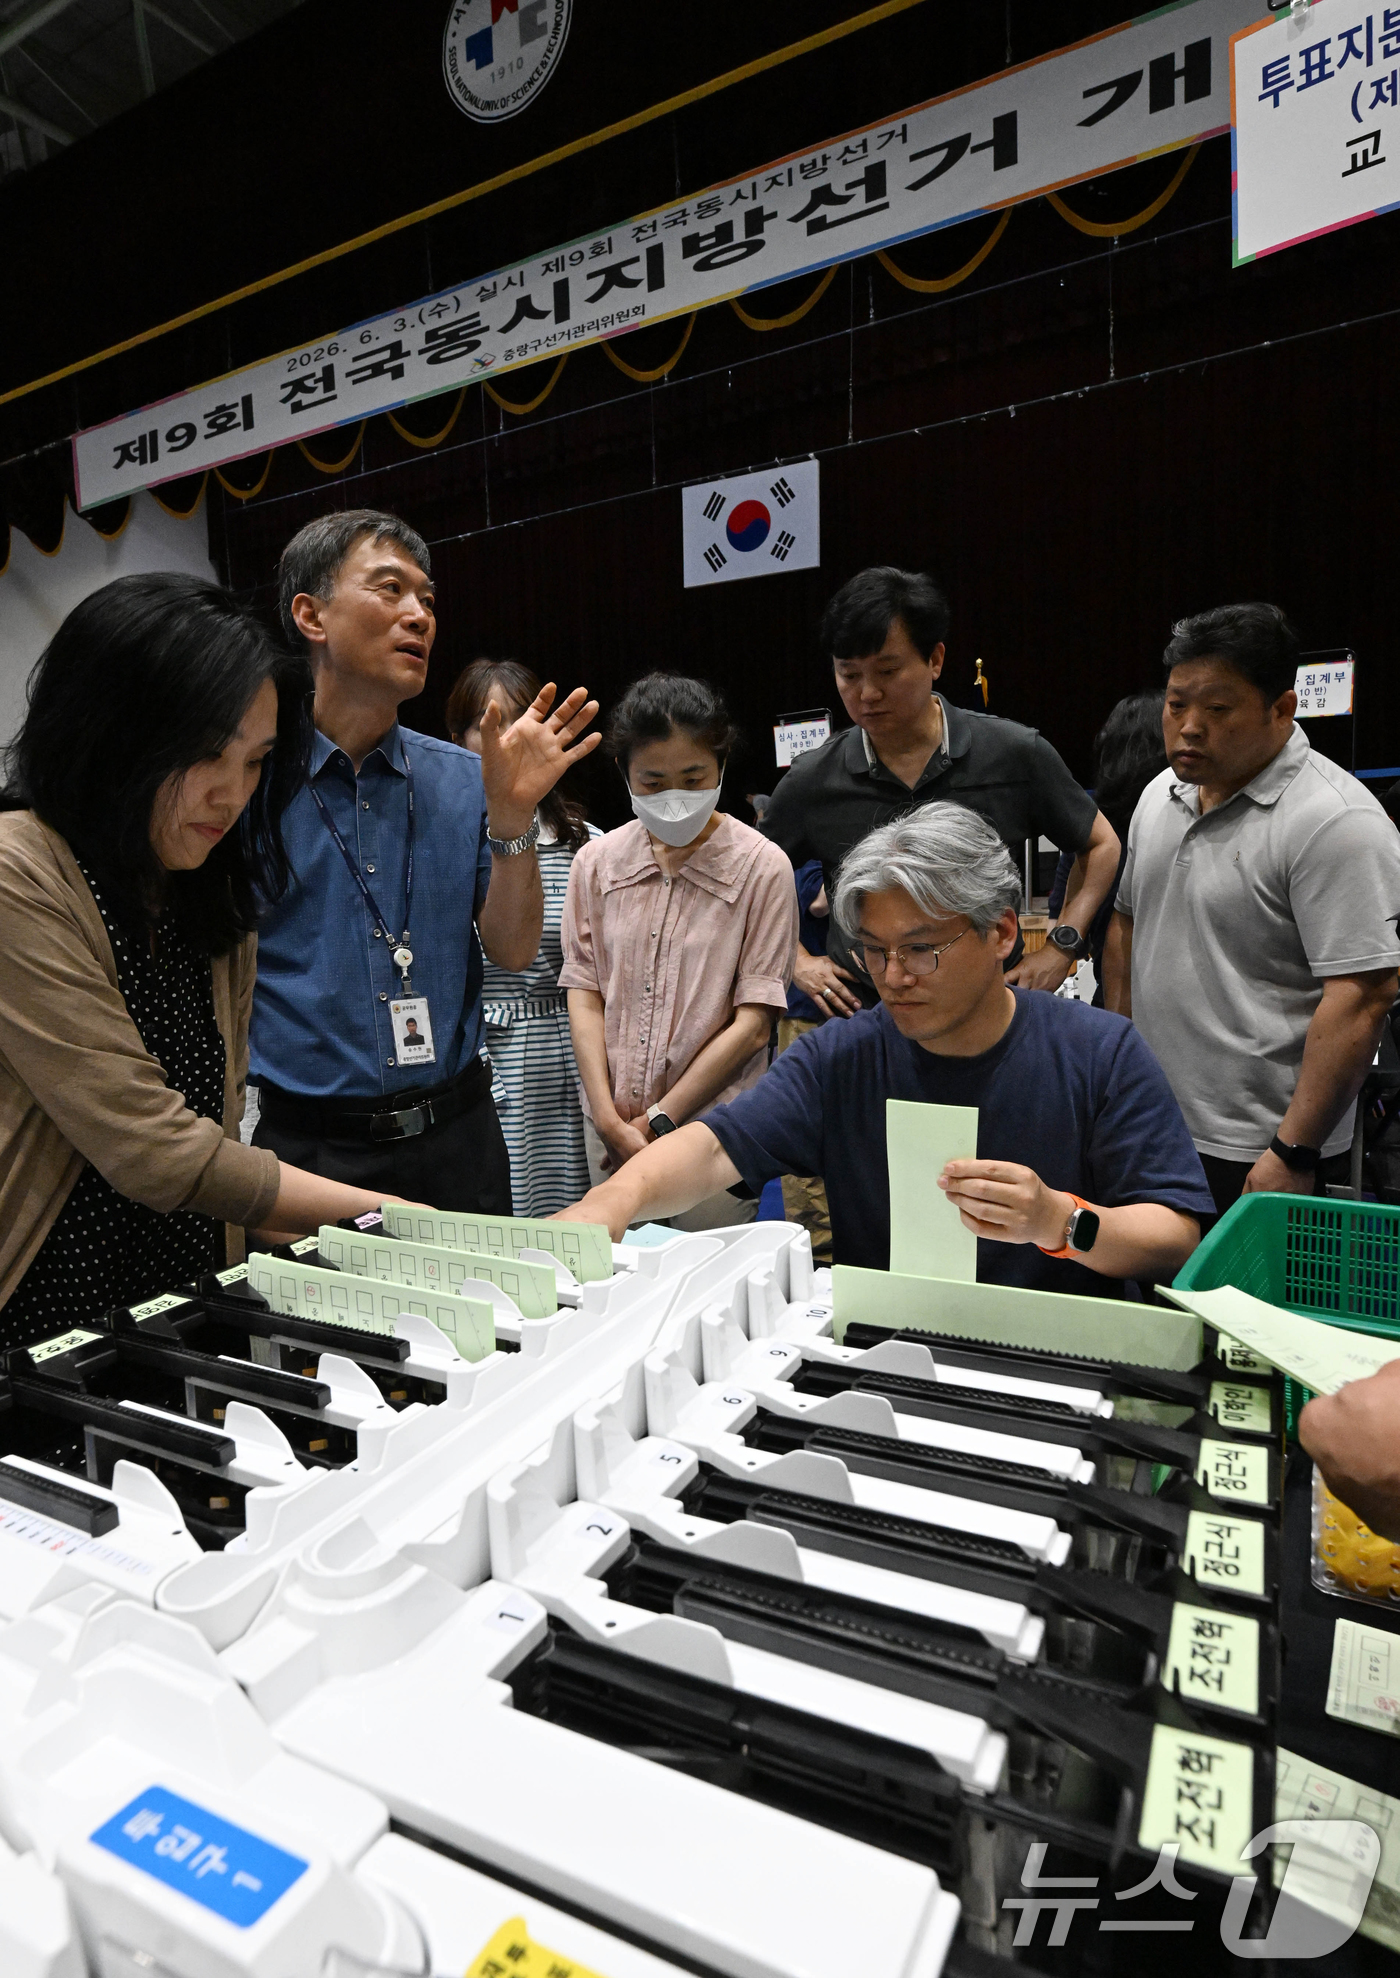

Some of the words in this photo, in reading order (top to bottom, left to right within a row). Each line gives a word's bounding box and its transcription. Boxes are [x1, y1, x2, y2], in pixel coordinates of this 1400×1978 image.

[490, 56, 525, 84] 1910
[511, 67, 544, 104] SCIENCE
[544, 0, 565, 61] TECHNOLO
[286, 342, 348, 373] 2026.
[475, 270, 525, 303] 실시
[541, 236, 614, 278] 제9회
[631, 123, 909, 244] 전국동시지방선거
[112, 394, 255, 472] 제9회
[279, 110, 1018, 414] 전국동시지방선거
[503, 303, 647, 361] 중랑구선거관리위원회
[805, 1309, 828, 1319] 10
[1222, 1387, 1254, 1423] 이학인
[660, 1453, 682, 1465] 5
[1214, 1447, 1248, 1491] 정근식
[586, 1523, 613, 1537] 2
[1203, 1521, 1241, 1577] 정근식
[1189, 1616, 1235, 1692] 조전혁
[1173, 1745, 1227, 1848] 조전혁
